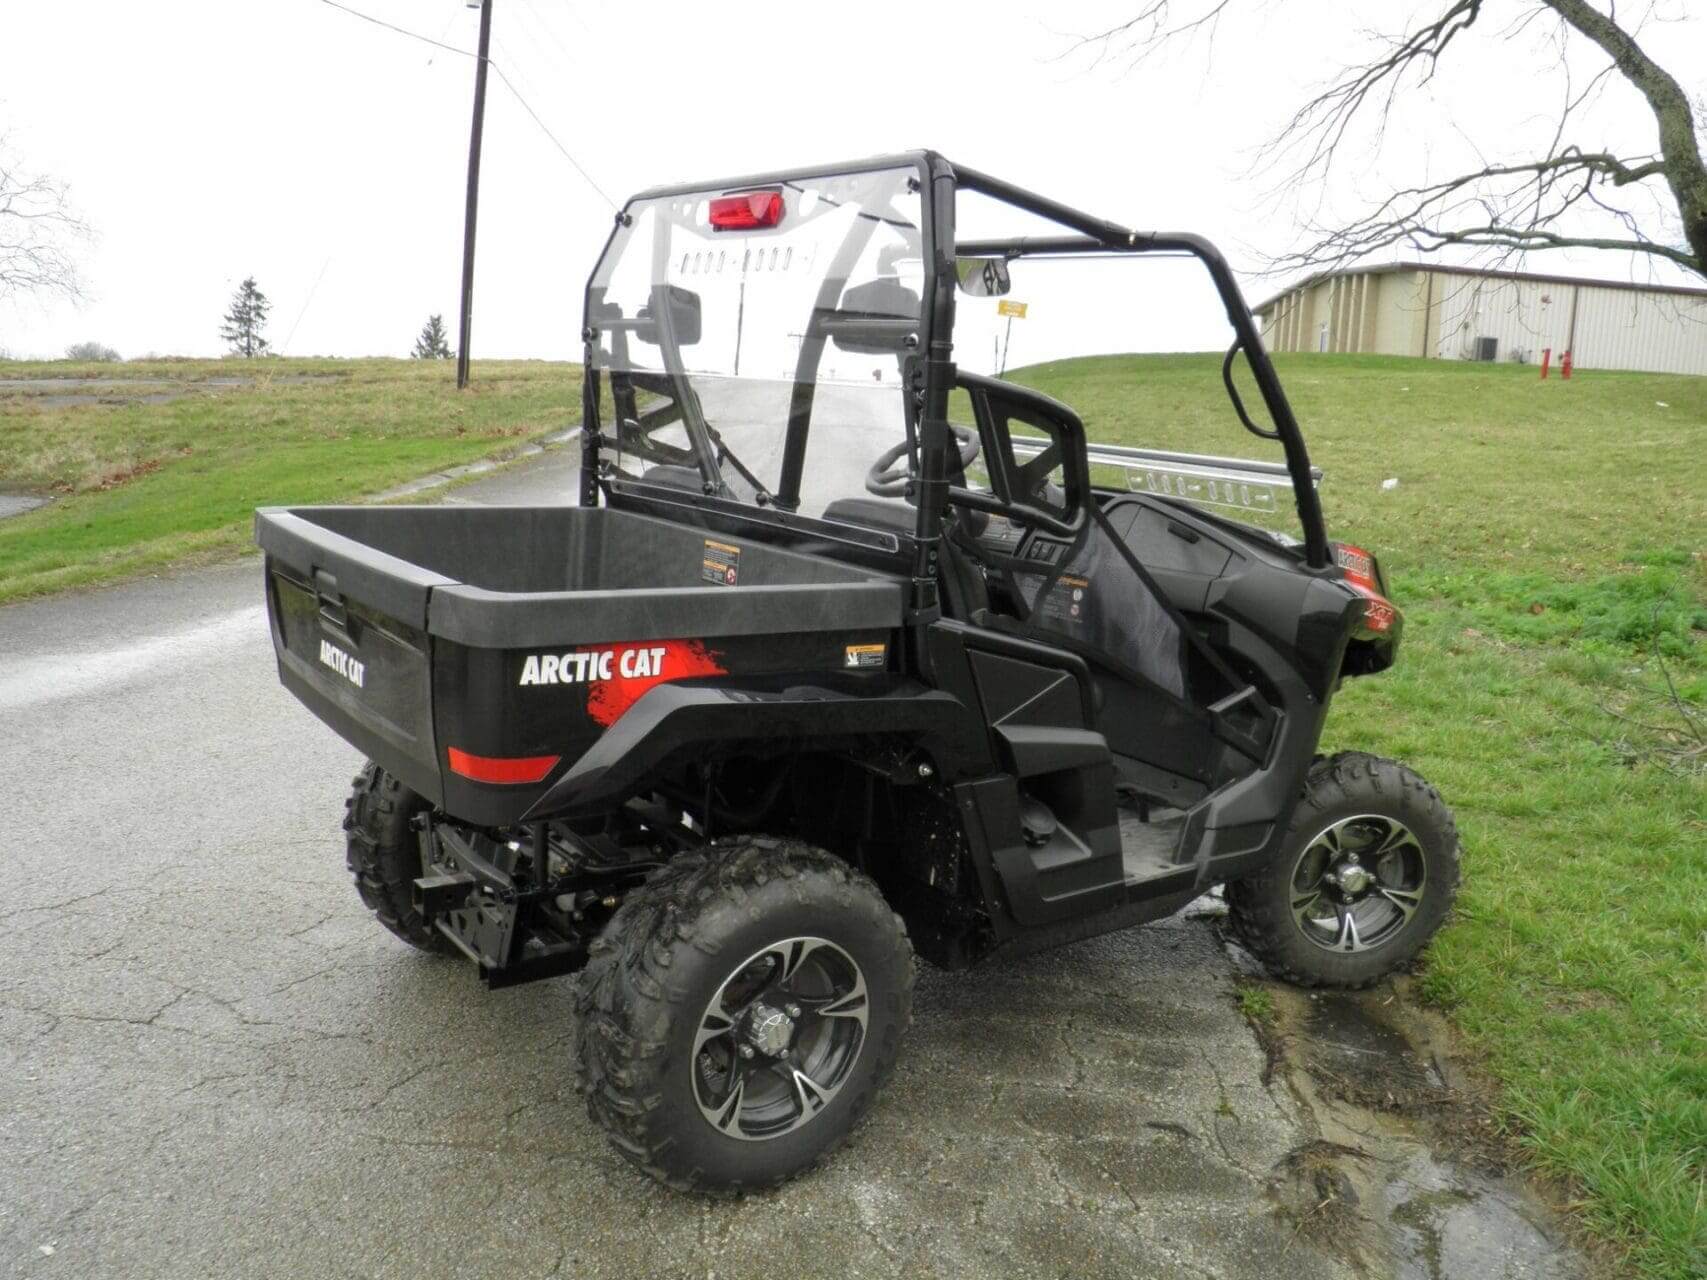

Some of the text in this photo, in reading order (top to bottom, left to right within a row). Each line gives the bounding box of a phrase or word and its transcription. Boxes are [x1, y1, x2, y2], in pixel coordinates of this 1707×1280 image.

[320, 639, 365, 688] ARCTIC CAT
[519, 647, 666, 685] ARCTIC CAT
